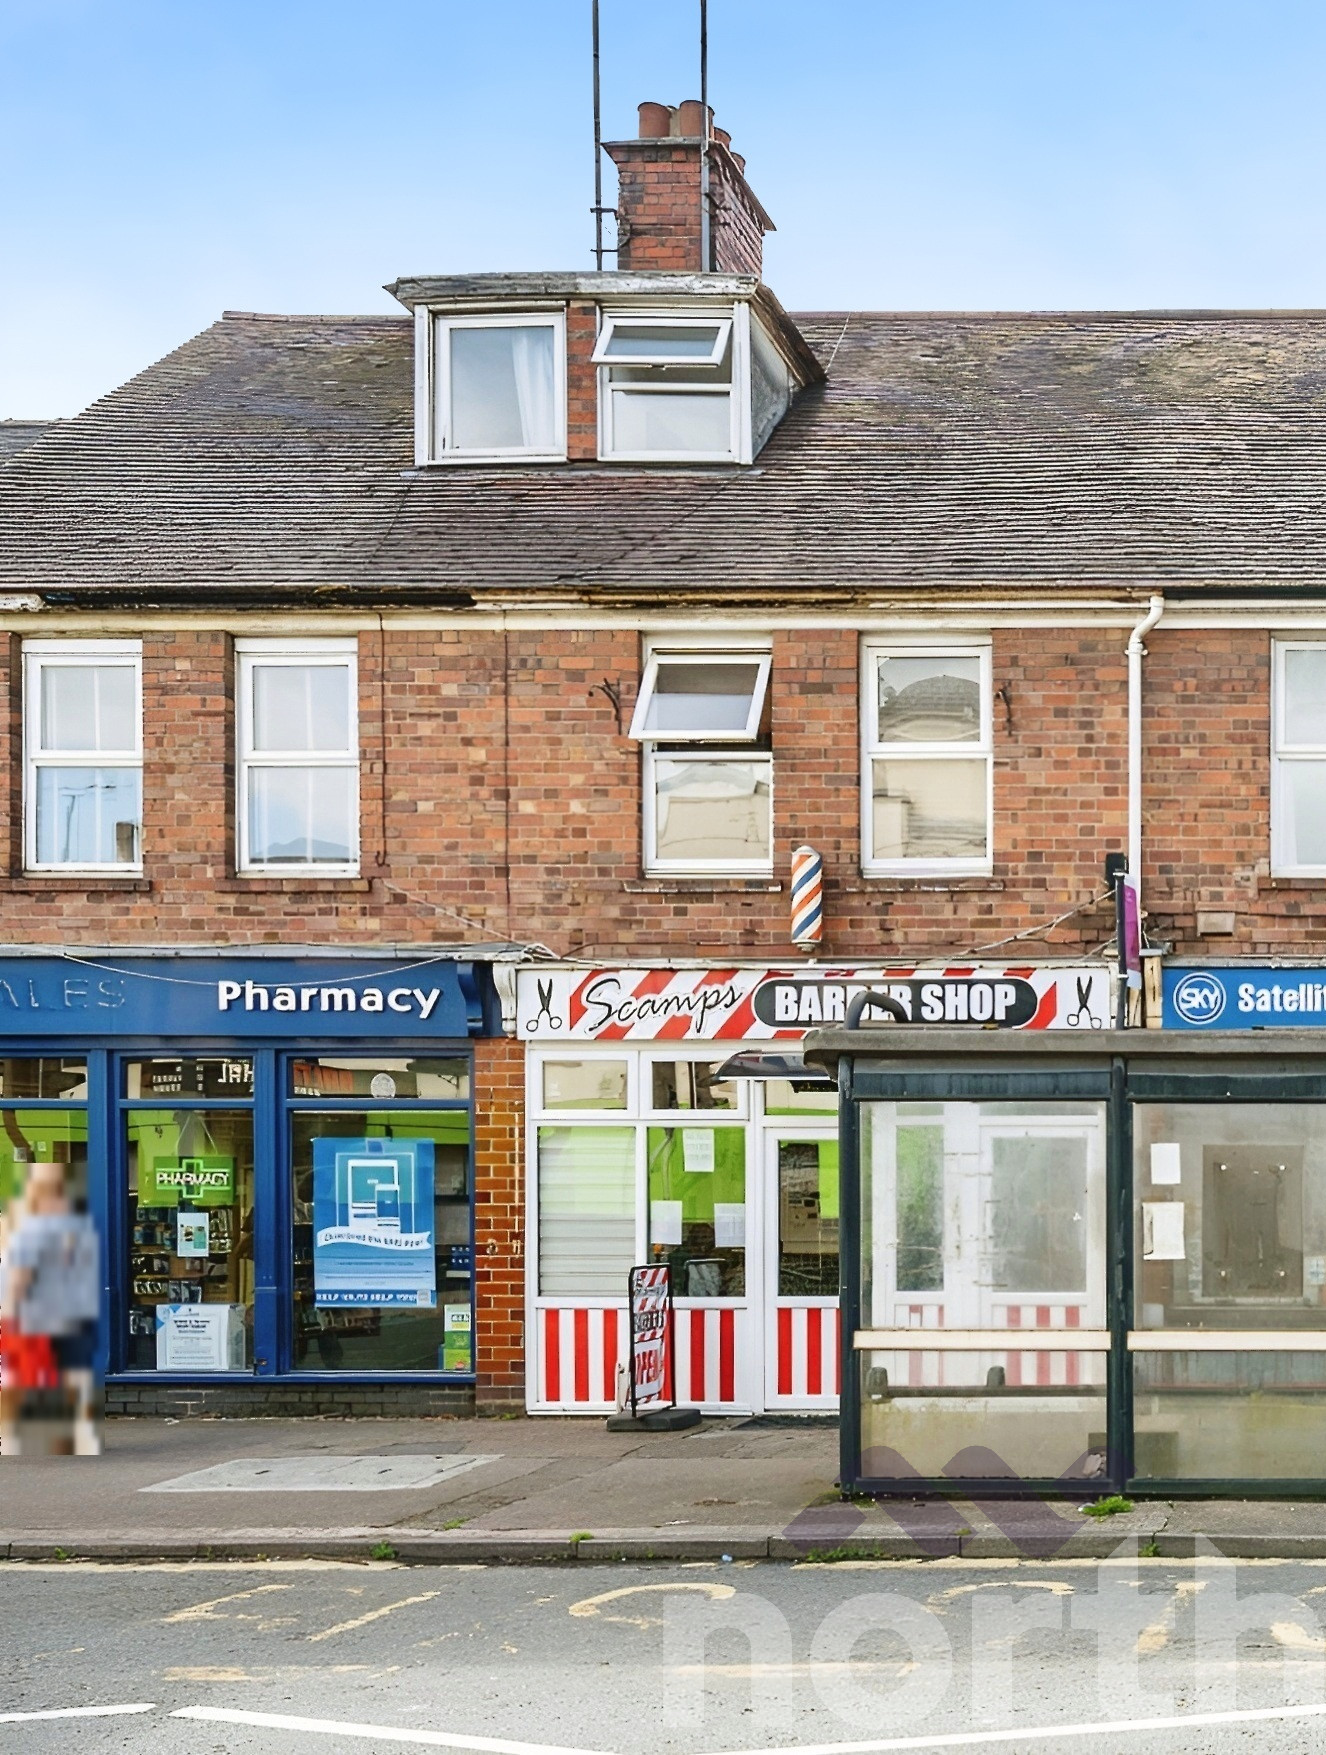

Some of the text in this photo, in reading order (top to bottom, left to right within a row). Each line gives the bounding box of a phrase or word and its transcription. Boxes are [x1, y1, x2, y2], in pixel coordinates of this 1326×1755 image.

[218, 980, 441, 1020] Pharmacy
[585, 977, 744, 1034] Scamps
[921, 983, 1016, 1021] SHOP
